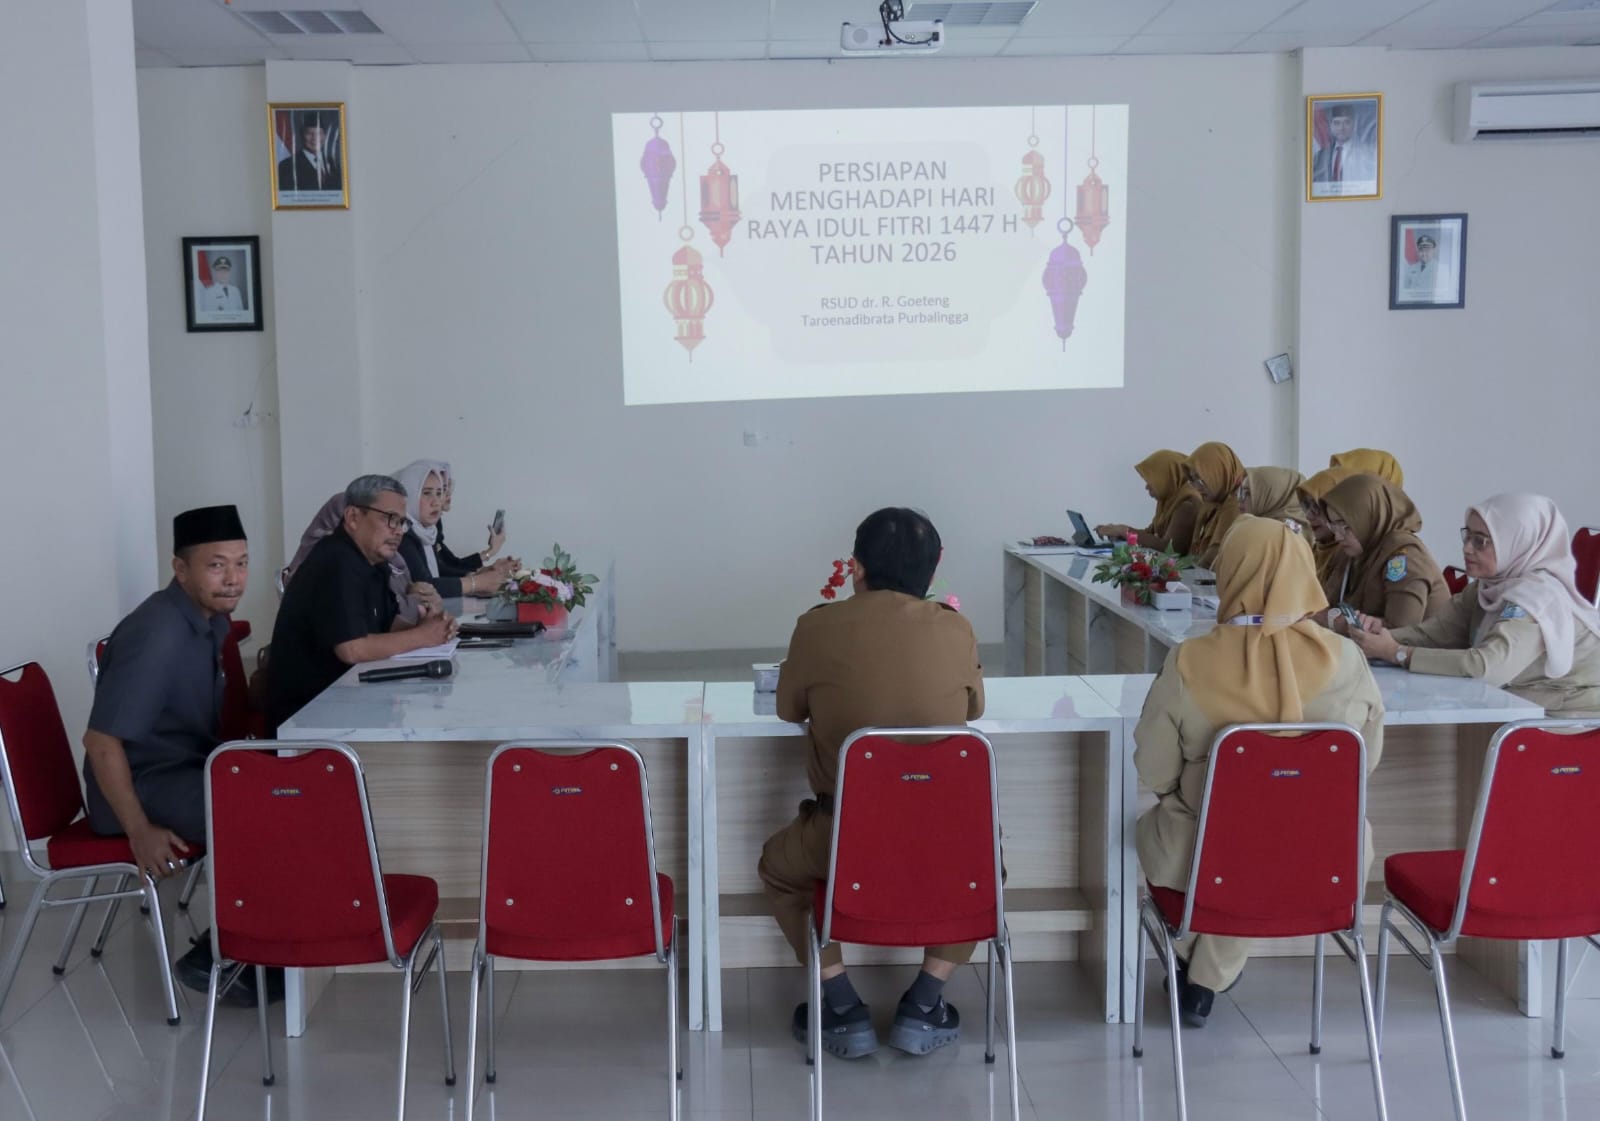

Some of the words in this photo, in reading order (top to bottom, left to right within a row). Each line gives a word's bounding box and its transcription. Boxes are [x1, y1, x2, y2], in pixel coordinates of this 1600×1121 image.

[819, 161, 947, 182] PERSIAPAN
[770, 188, 933, 211] MENGHADAPI
[941, 187, 995, 206] HARI
[748, 219, 809, 239] RAYA
[816, 217, 870, 237] IDUL
[877, 216, 931, 236] FITRI
[940, 215, 994, 234] 1447
[1002, 214, 1018, 233] H
[810, 244, 893, 264] TAHUN
[901, 242, 957, 262] 2026
[820, 297, 858, 310] RSUD
[862, 297, 879, 308] dr.
[882, 296, 894, 307] R.
[897, 295, 950, 308] Goeteng
[801, 313, 894, 327] Taroenadibrata
[898, 312, 969, 325] Purbalingga
